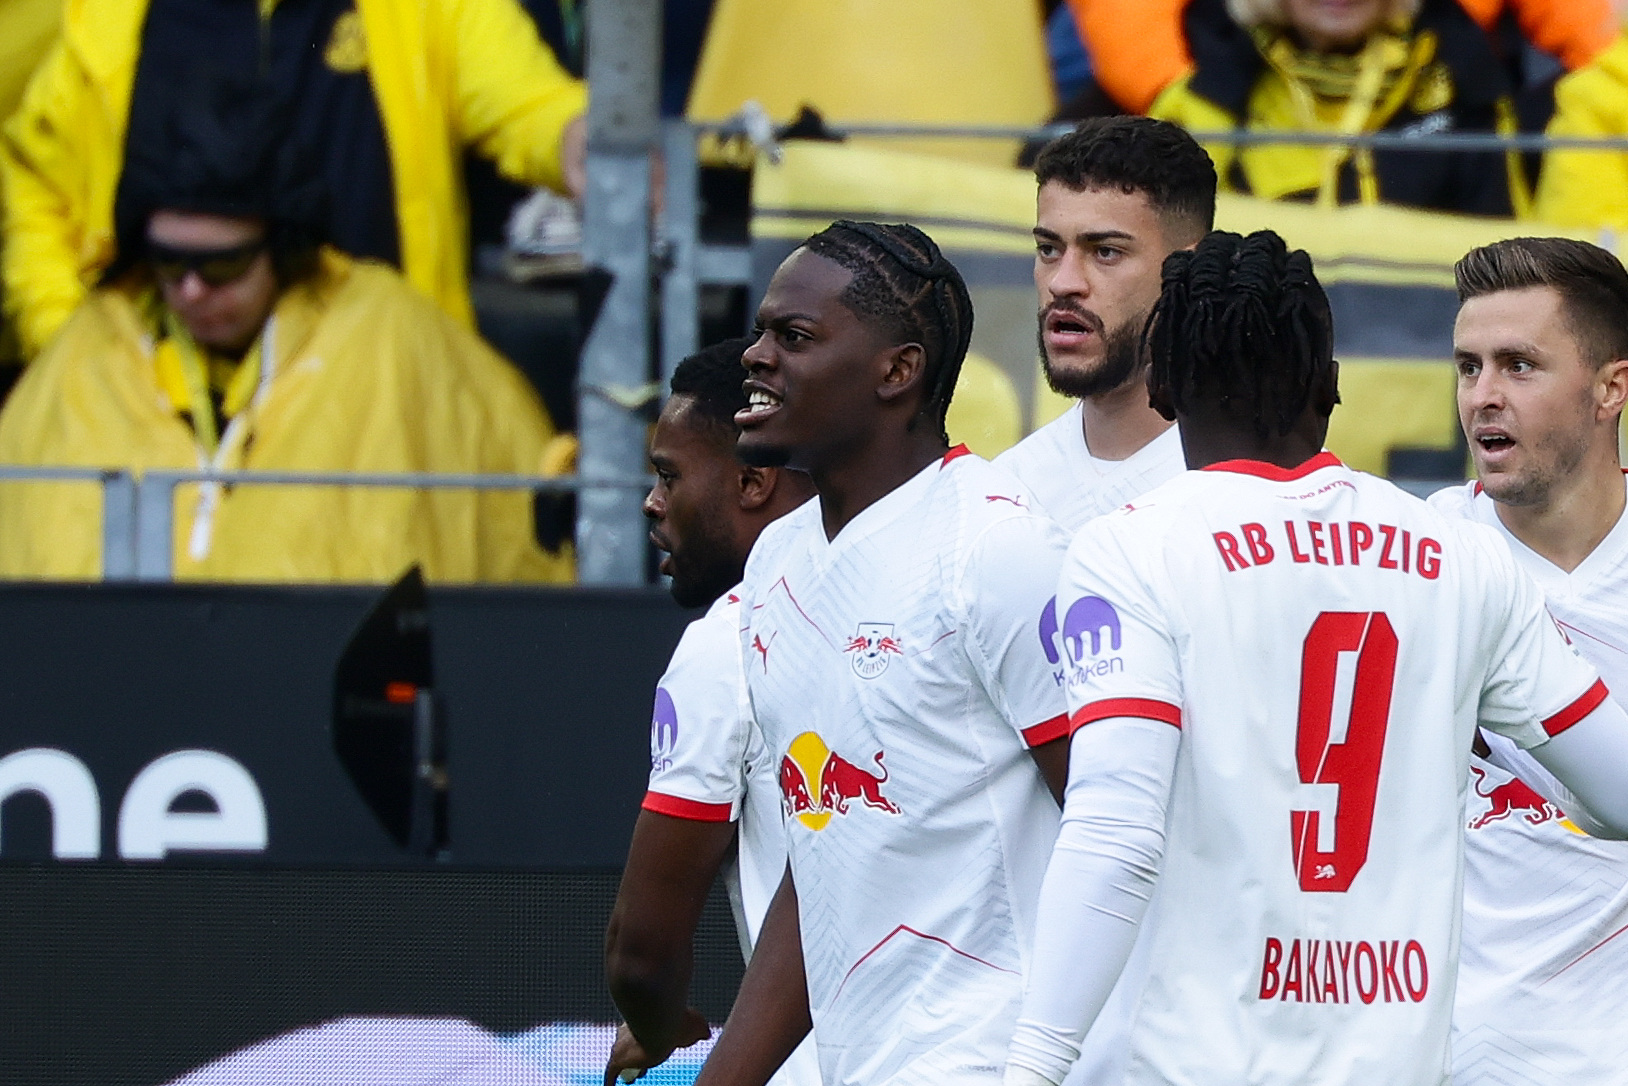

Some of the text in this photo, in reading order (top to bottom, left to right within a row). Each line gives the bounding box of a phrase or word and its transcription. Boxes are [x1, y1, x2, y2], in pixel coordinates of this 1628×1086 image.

[1212, 519, 1443, 581] RB LEIPZIG
[1289, 611, 1400, 893] 9
[1257, 936, 1429, 1005] BAKAYOKO
